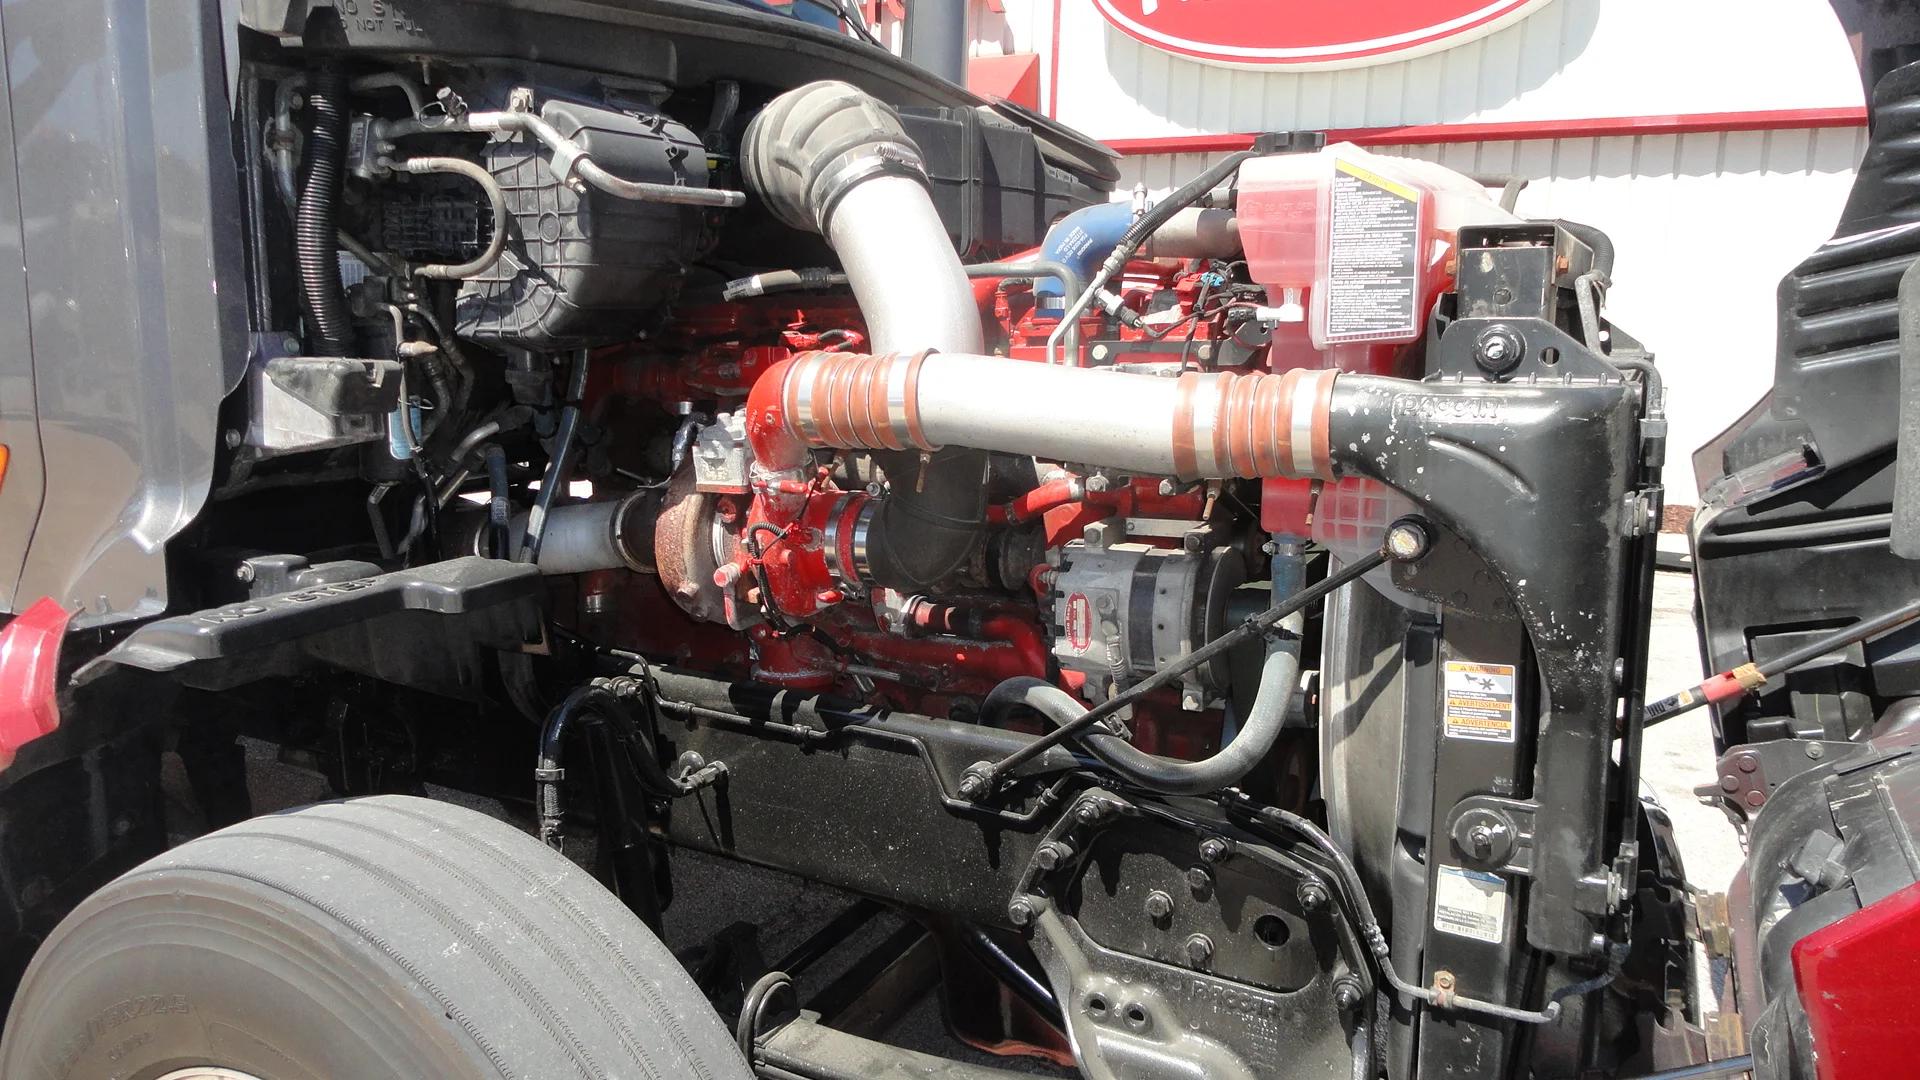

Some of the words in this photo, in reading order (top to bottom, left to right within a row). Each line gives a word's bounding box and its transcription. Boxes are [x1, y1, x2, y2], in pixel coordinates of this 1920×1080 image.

[335, 0, 358, 15] NO
[357, 19, 384, 32] NOT
[1399, 395, 1499, 419] PACCAR
[199, 605, 268, 624] NO
[287, 578, 376, 602] STEP
[1468, 665, 1501, 674] WARNING
[1458, 699, 1511, 710] AVERTISSEMENT
[1461, 718, 1508, 728] ADVERTENCIA
